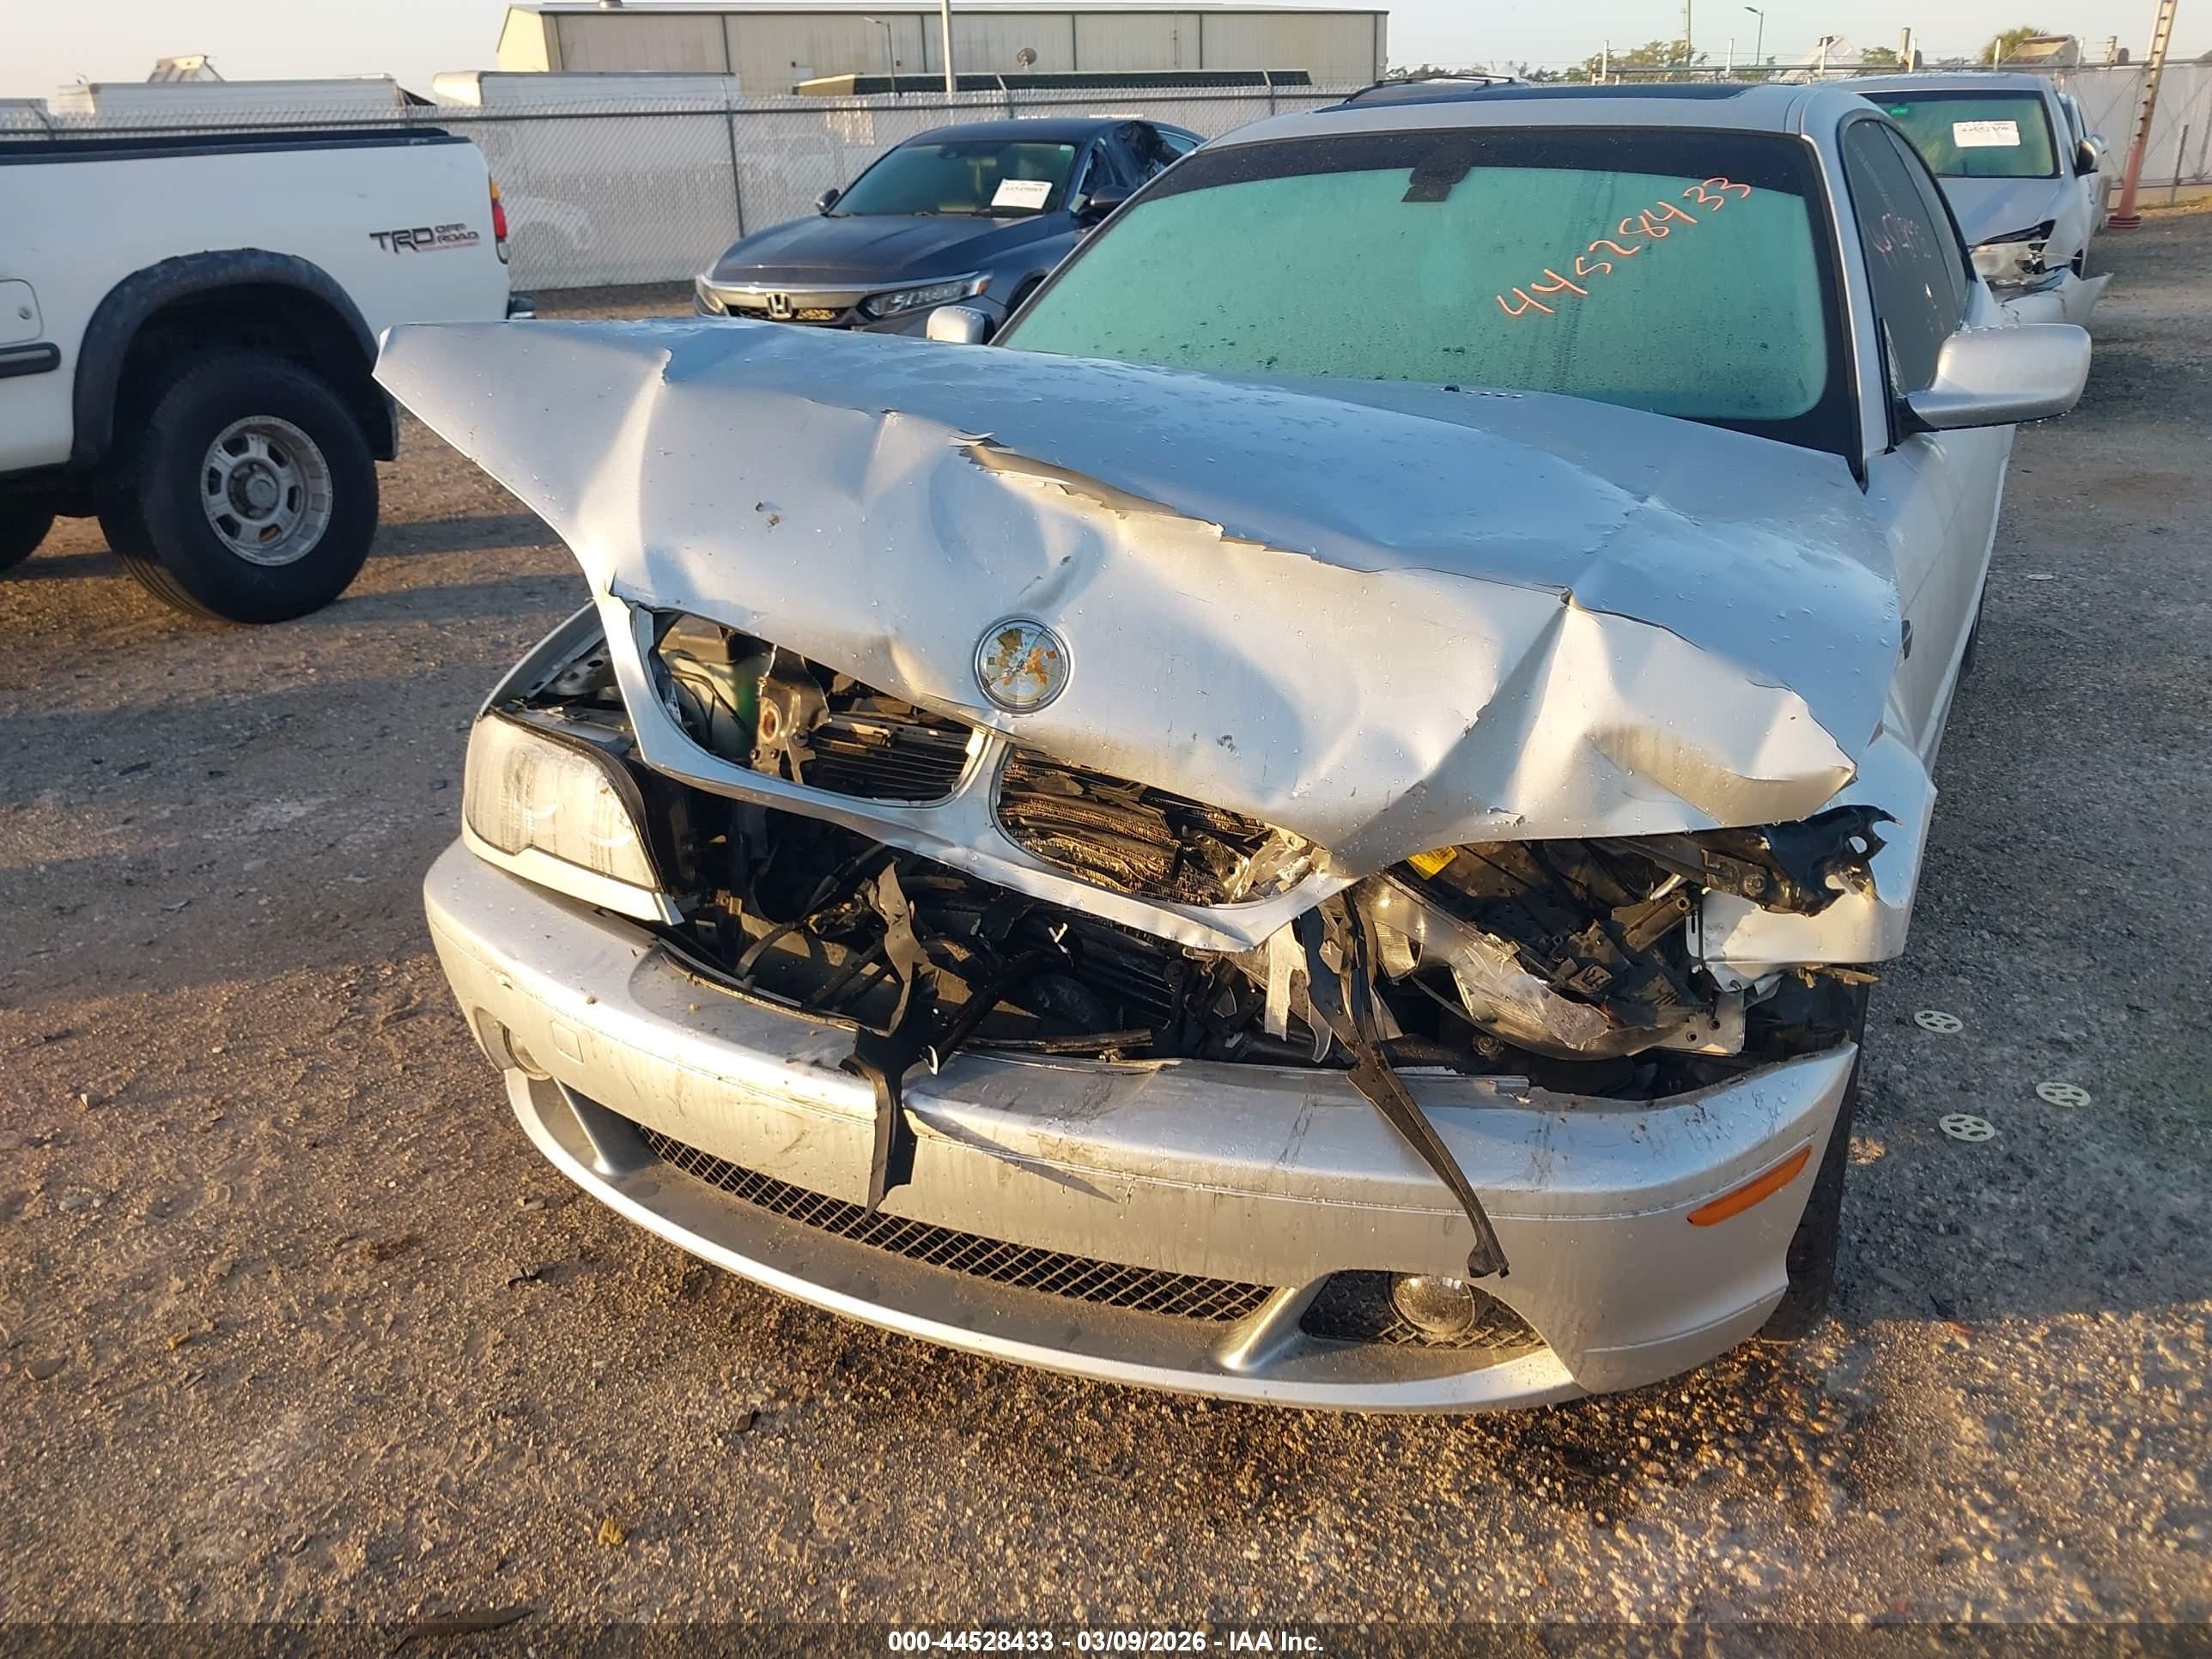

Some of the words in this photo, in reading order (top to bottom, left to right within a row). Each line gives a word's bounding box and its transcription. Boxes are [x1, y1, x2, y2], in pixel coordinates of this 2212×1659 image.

[434, 223, 466, 234] OFF
[437, 231, 479, 242] ROAD
[369, 227, 434, 254] TRD
[1497, 177, 1751, 315] 44528433
